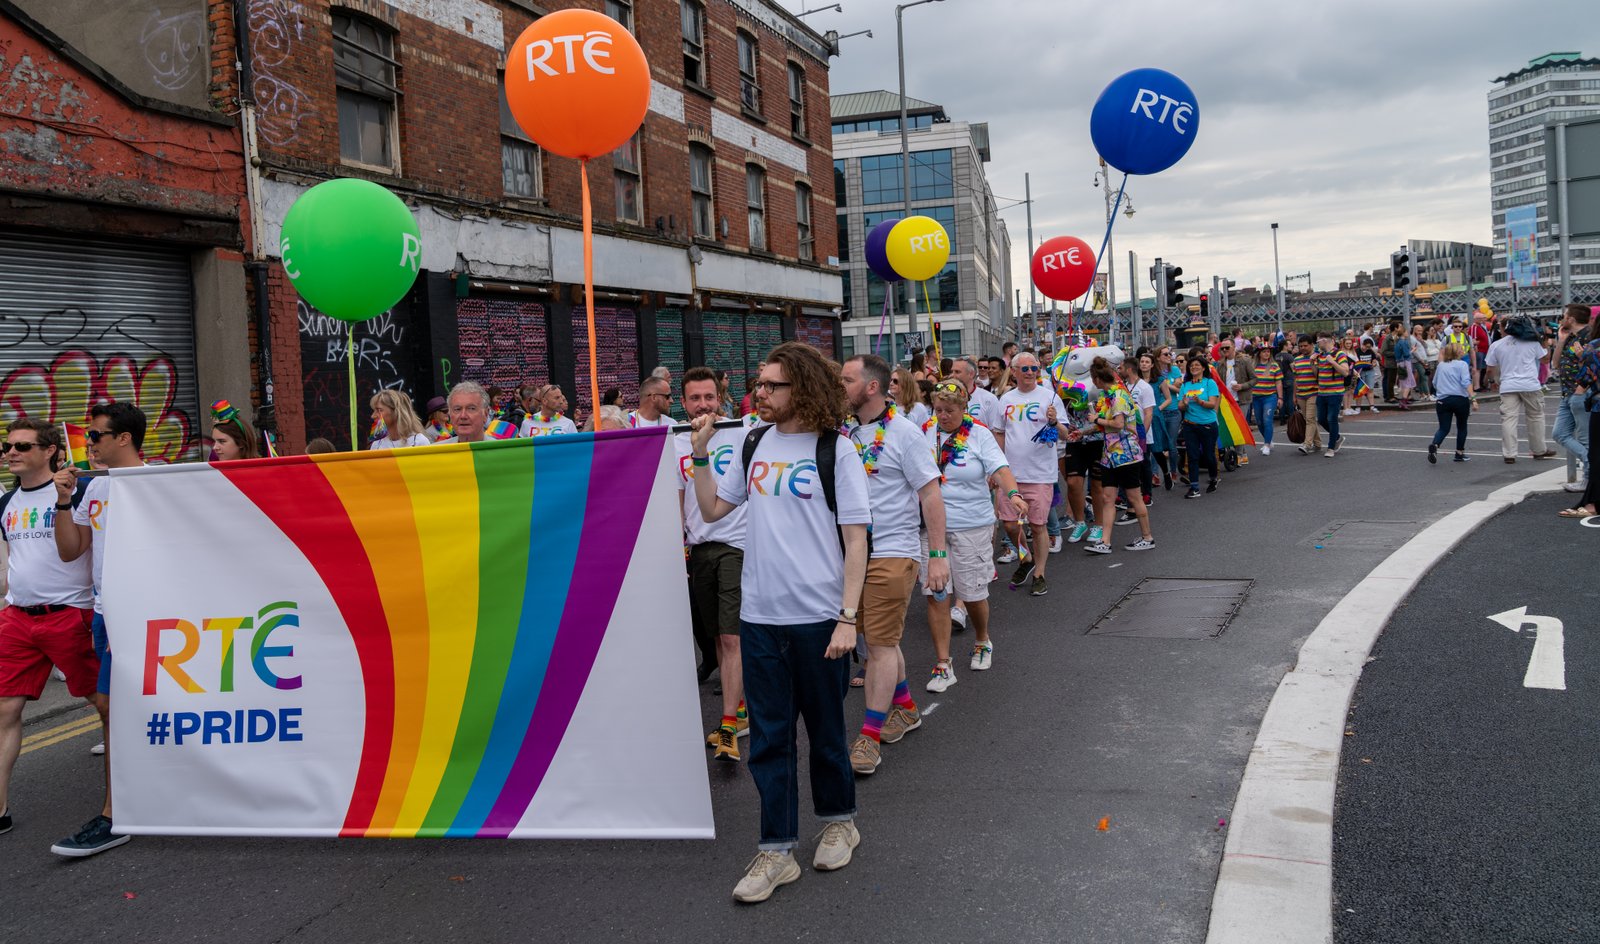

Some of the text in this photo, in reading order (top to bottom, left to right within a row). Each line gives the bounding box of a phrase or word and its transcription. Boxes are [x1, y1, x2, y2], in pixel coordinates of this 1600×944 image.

[525, 30, 616, 82] RTÉ
[1130, 88, 1194, 135] RTÉ
[909, 229, 945, 254] RTÉ
[1041, 246, 1083, 273] RTÉ
[1004, 402, 1041, 422] RTÉ
[679, 444, 734, 483] RÉ
[748, 458, 817, 500] RTÉ
[22, 532, 30, 540] IS
[31, 531, 53, 540] LOVE
[142, 600, 303, 696] RTÉ
[146, 708, 304, 746] #PRIDE
